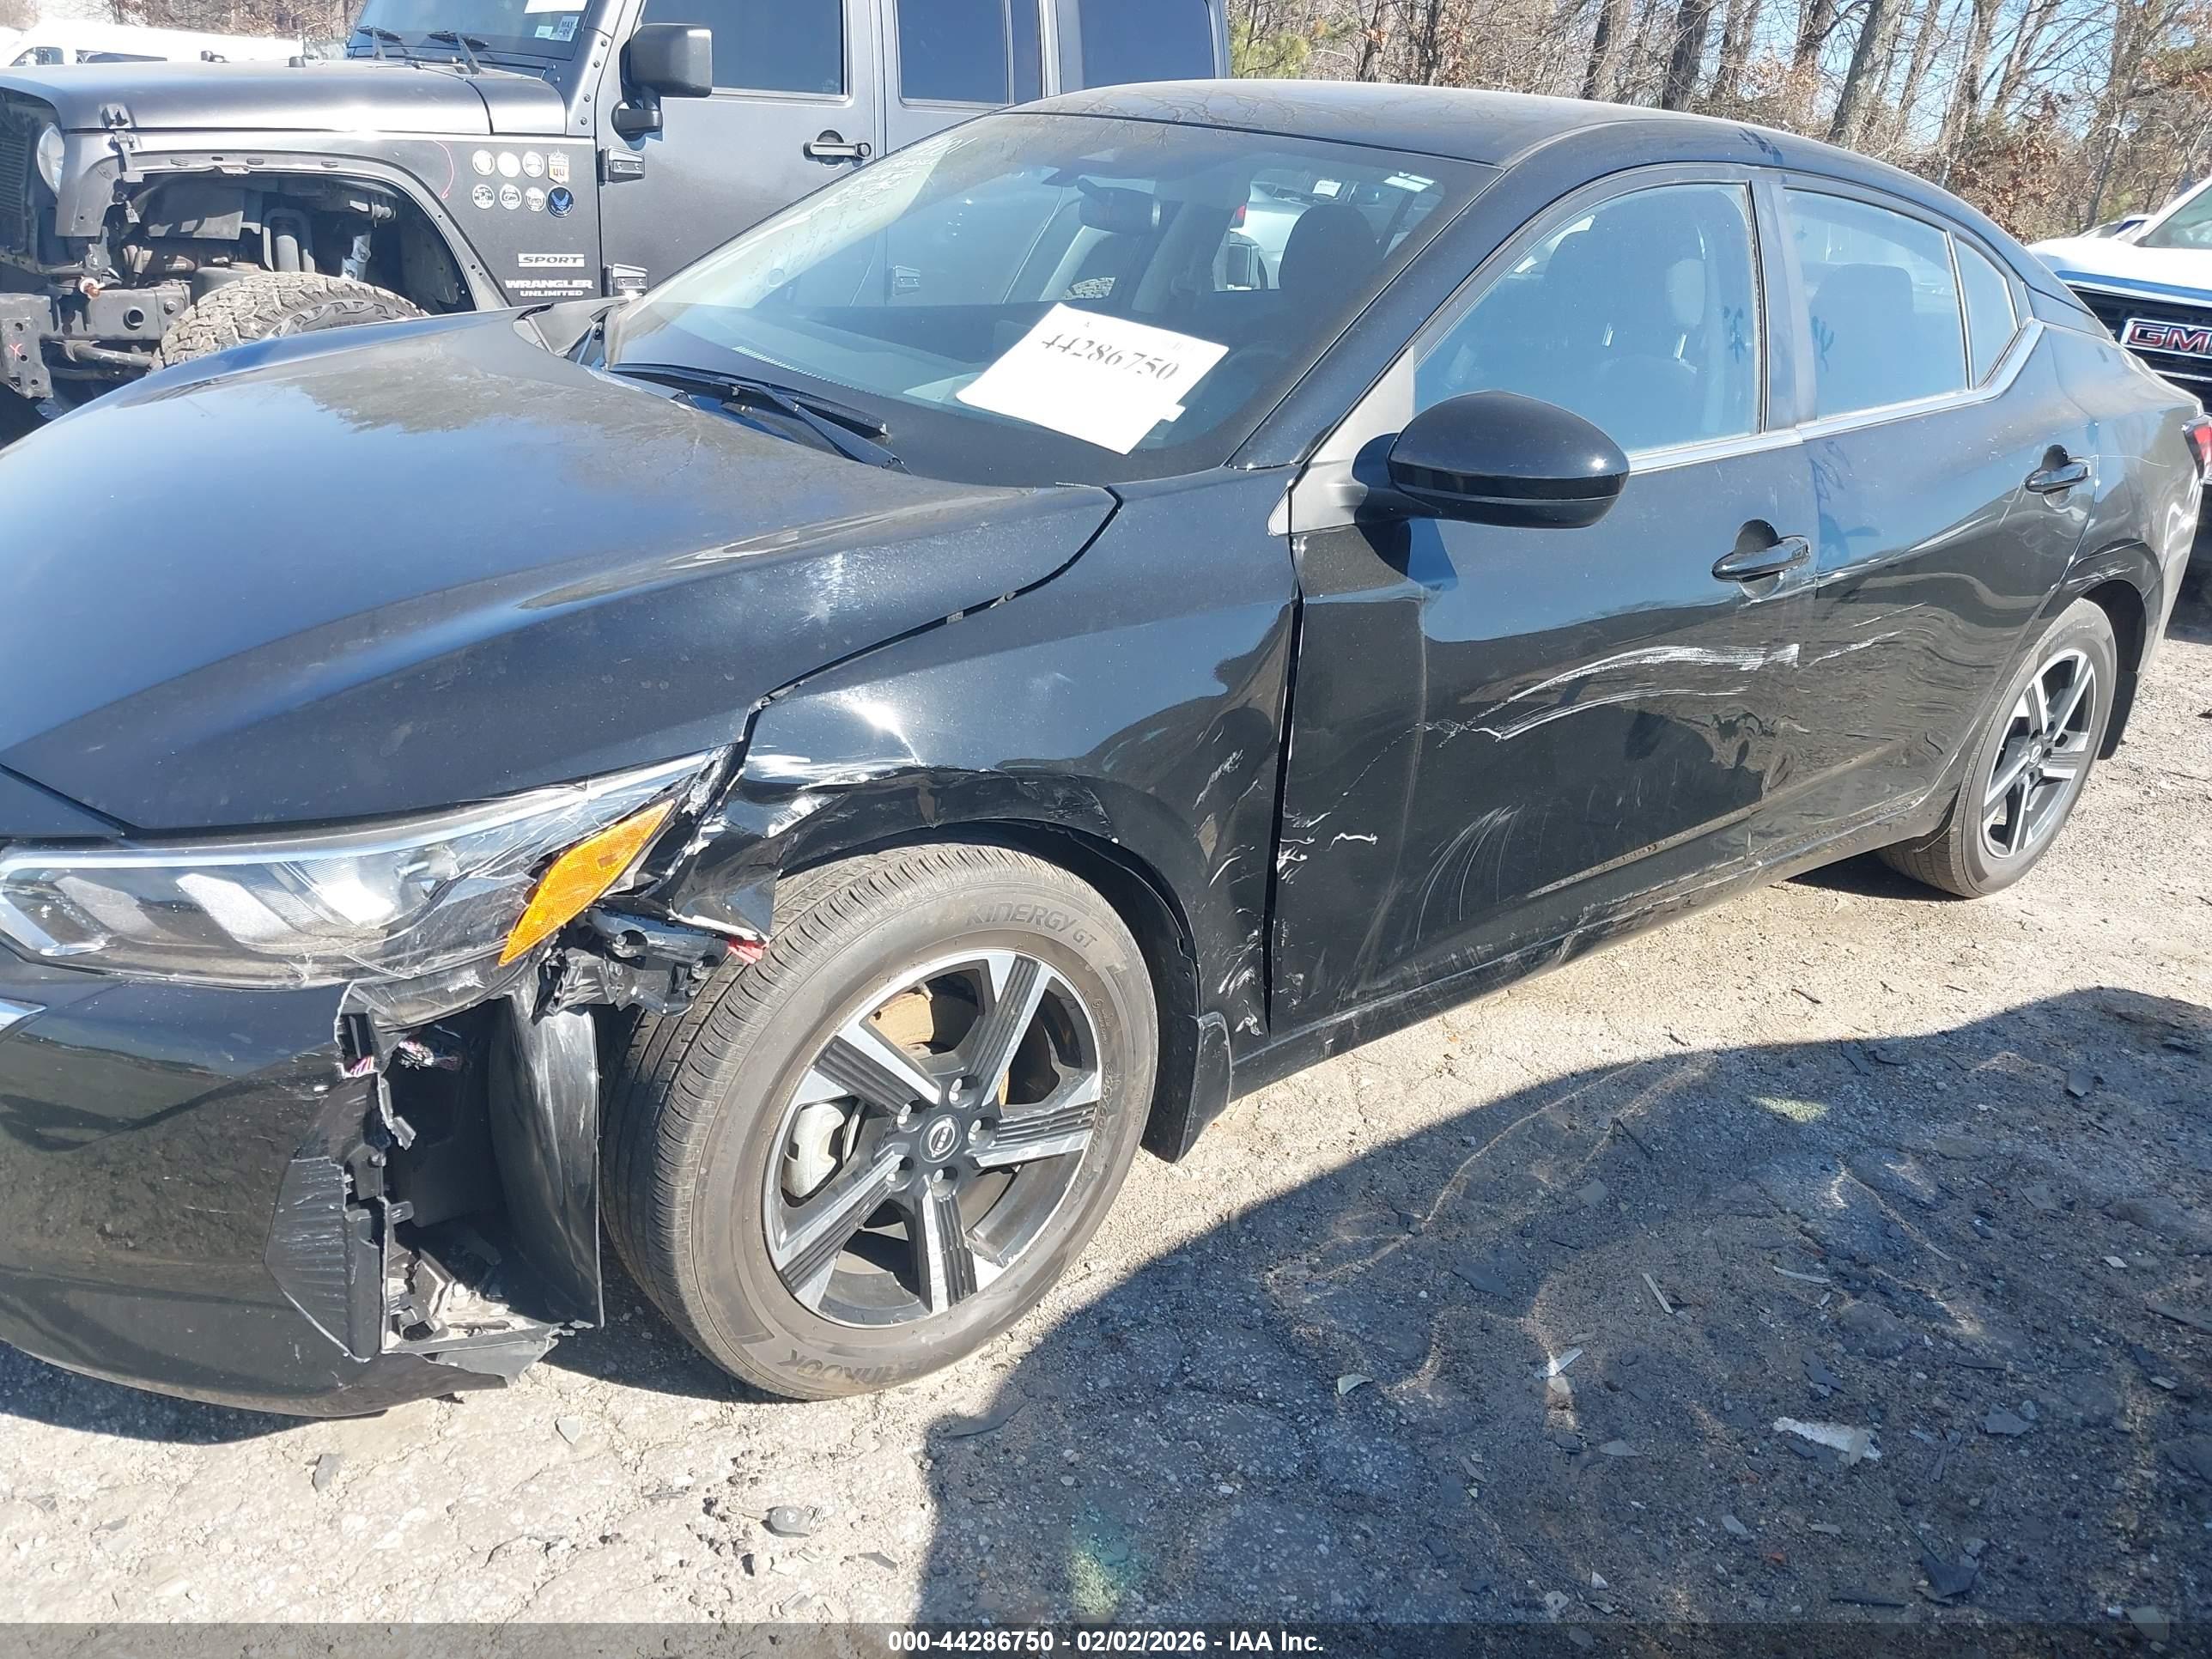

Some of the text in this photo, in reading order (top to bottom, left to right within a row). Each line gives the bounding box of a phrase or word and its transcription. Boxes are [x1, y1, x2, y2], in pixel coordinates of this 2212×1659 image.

[519, 256, 584, 264] SPORT
[505, 280, 594, 289] WRANGLER
[2129, 323, 2212, 354] GM
[1042, 333, 1180, 380] 44286750
[965, 902, 1097, 948] KINERGY GT
[776, 1349, 921, 1385] ANKOOK
